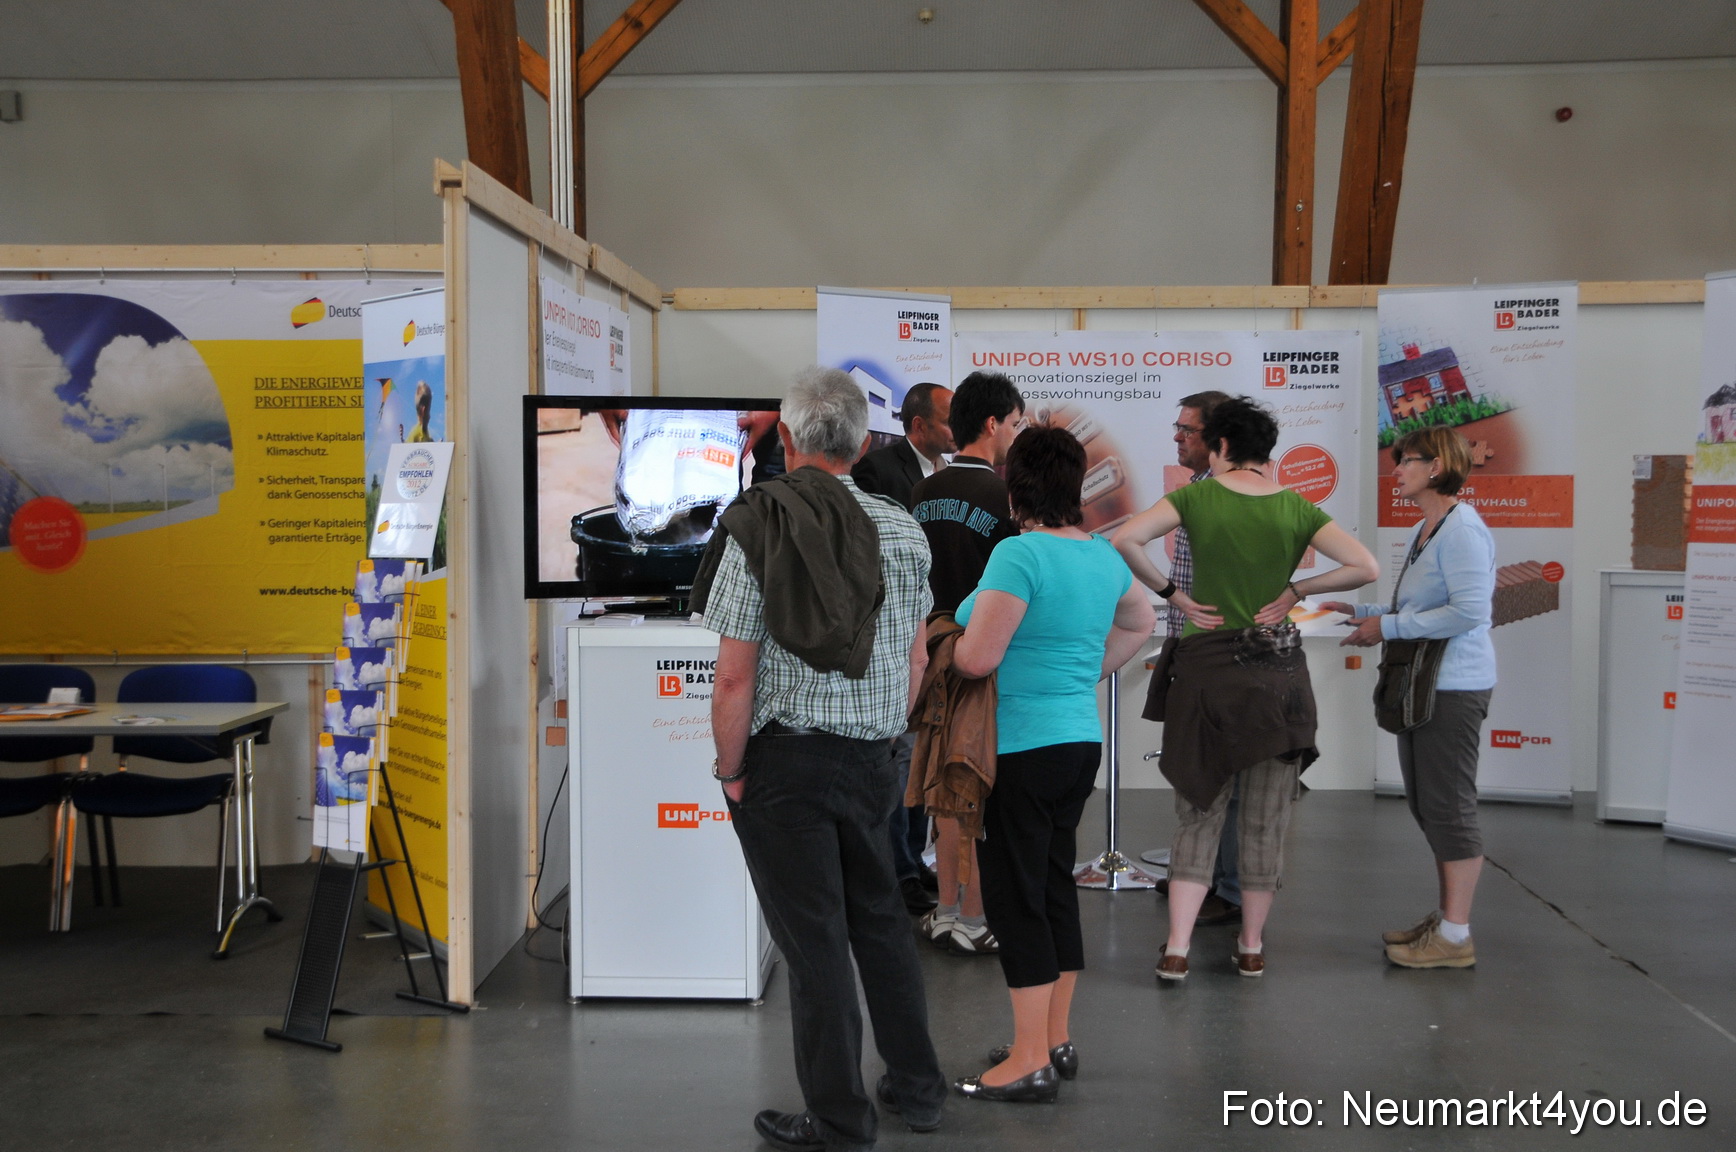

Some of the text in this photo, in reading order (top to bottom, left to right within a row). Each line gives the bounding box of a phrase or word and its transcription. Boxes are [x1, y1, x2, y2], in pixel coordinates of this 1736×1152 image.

[1494, 298, 1560, 309] LEIPFINGER
[898, 311, 940, 321] LEIPFINGER
[1517, 308, 1560, 319] BADER
[912, 321, 940, 332] BADER
[972, 351, 1233, 367] UNIPOR WS10 CORISO
[1263, 352, 1339, 363] LEIPFINGER
[1290, 364, 1340, 375] BADER
[1143, 371, 1162, 383] im
[255, 376, 279, 390] DIE
[255, 395, 346, 408] PROFITIEREN
[1281, 401, 1345, 416] Entscheidung
[1295, 415, 1323, 427] Leben
[266, 432, 314, 442] Attraktive
[266, 446, 329, 456] Klimaschutz.
[399, 469, 433, 478] EMPFOHLEN
[267, 475, 317, 486] Sicherheit,
[268, 490, 293, 499] dank
[268, 518, 311, 530] Geringer
[966, 506, 999, 537] AVE
[268, 533, 365, 544] garantierte Erträge.
[653, 718, 676, 728] Eine
[1495, 734, 1552, 745] UNIPOR
